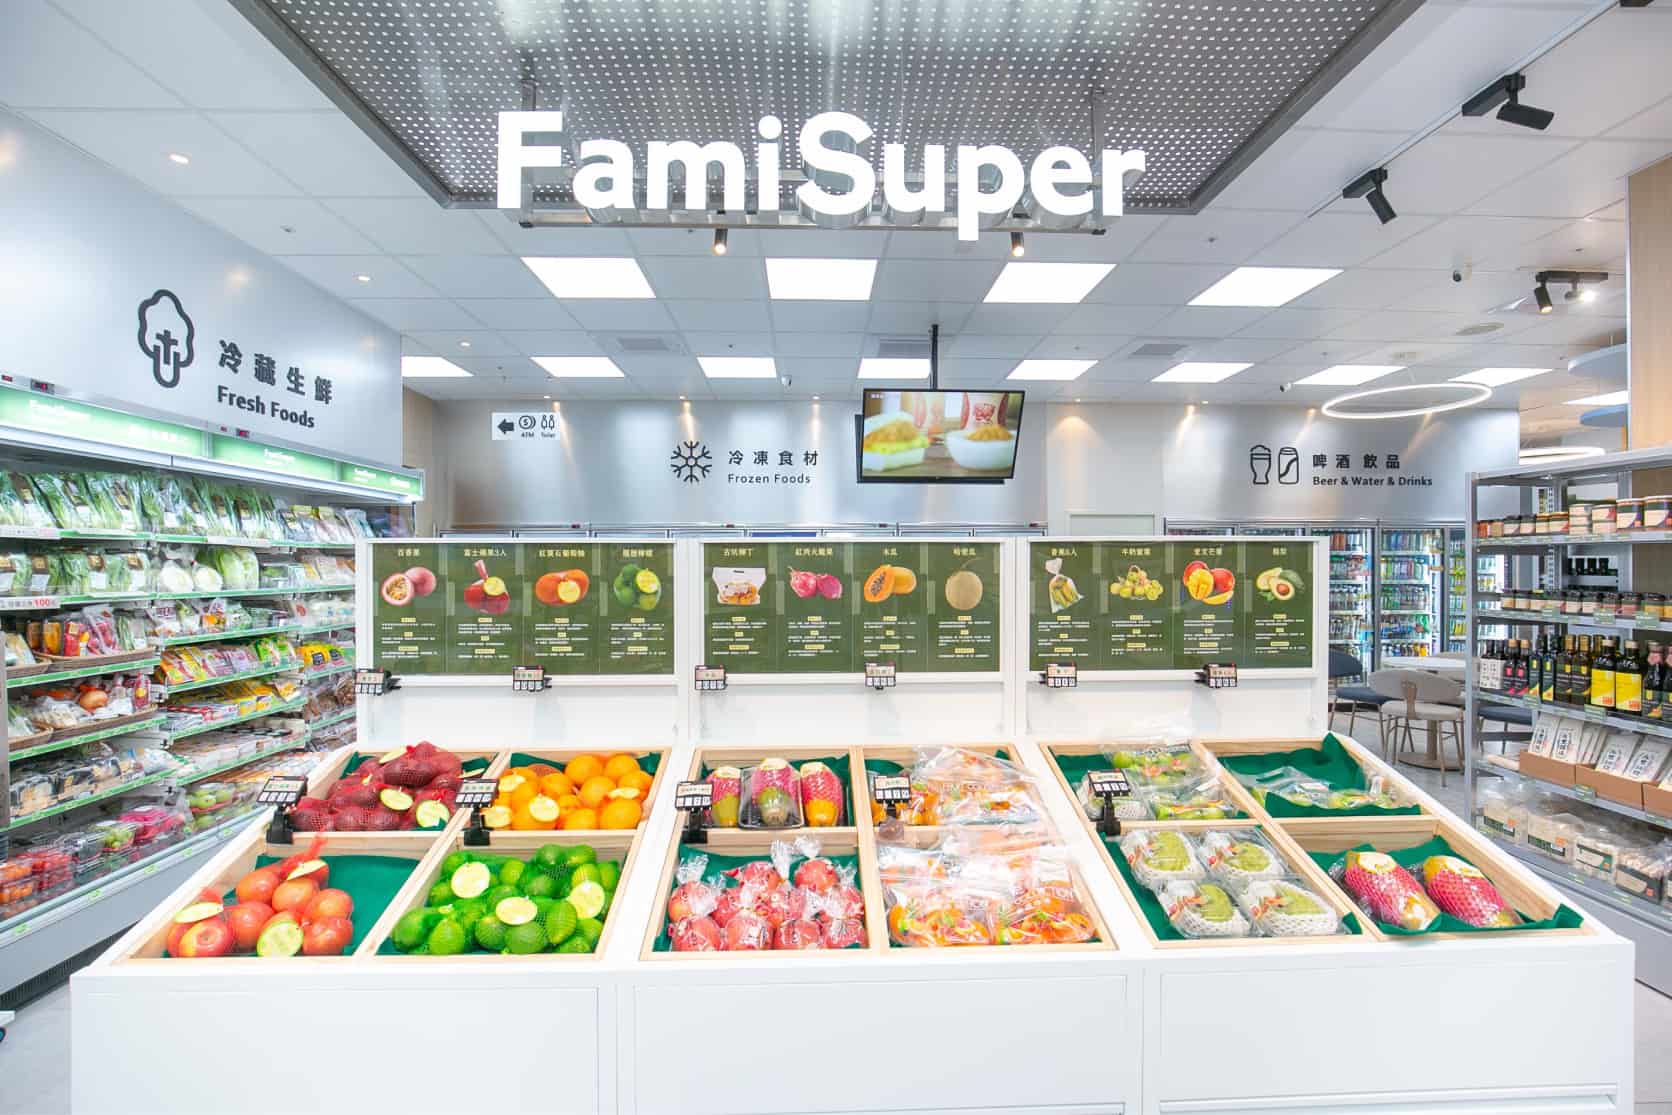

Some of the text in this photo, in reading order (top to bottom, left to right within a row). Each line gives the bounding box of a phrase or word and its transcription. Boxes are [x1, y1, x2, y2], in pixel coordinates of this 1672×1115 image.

[496, 110, 1147, 242] FamiSuper
[219, 339, 334, 405] 冷藏生鮮
[217, 384, 316, 429] Fresh Foods
[728, 449, 819, 467] 冷凍食材
[1312, 454, 1400, 469] 啤酒飲品
[728, 473, 811, 484] Frozen Foods
[1313, 476, 1433, 486] Beer & Water & Drinks
